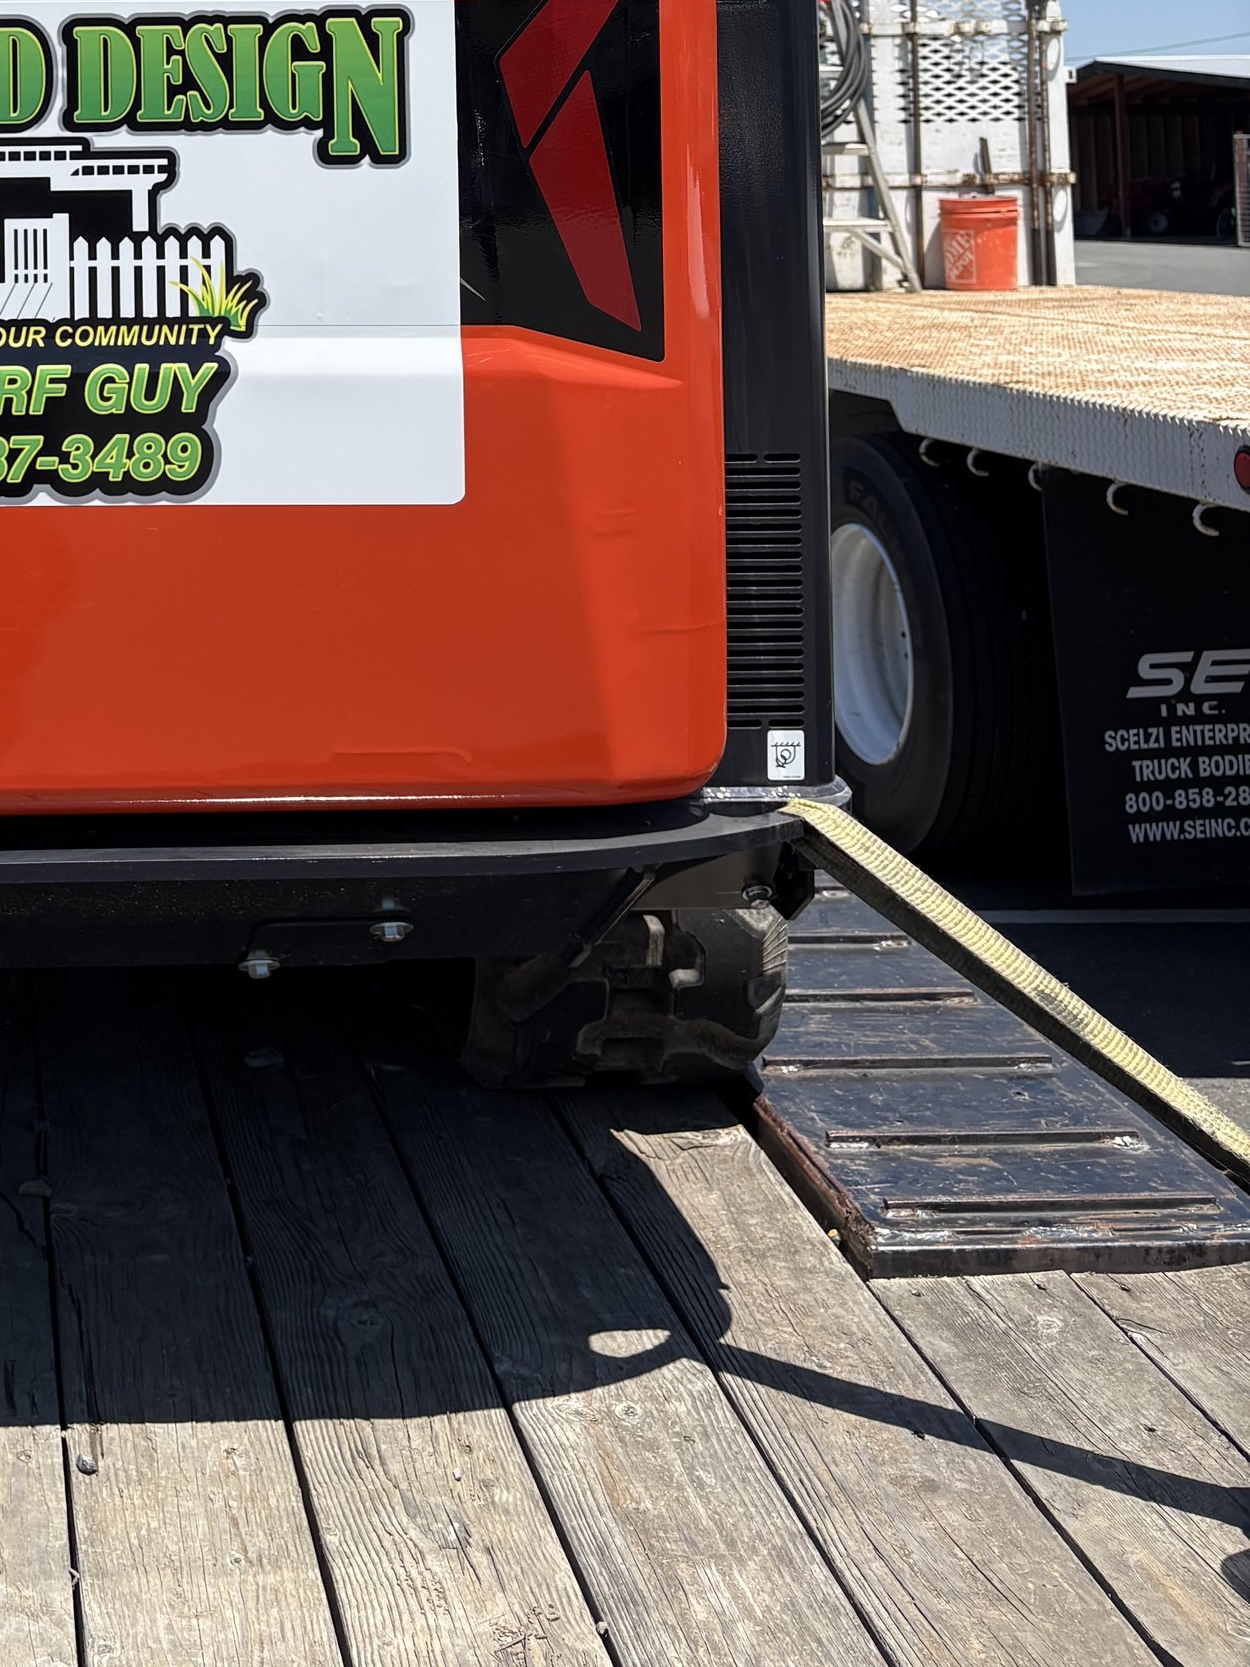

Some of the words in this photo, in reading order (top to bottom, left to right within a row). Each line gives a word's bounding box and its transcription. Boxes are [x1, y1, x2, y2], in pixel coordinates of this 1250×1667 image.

[73, 17, 403, 155] DESIGN
[54, 323, 224, 347] COMMUNITY
[84, 362, 219, 414] GUY
[1126, 648, 1250, 699] SE
[1160, 700, 1226, 718] INC.
[1104, 726, 1165, 752] SCELZI
[1171, 722, 1250, 748] ENTERPR
[1131, 756, 1193, 783] TRUCK
[1125, 785, 1250, 814] 800-858-28
[1128, 817, 1250, 844] WWW.SEINC.C
